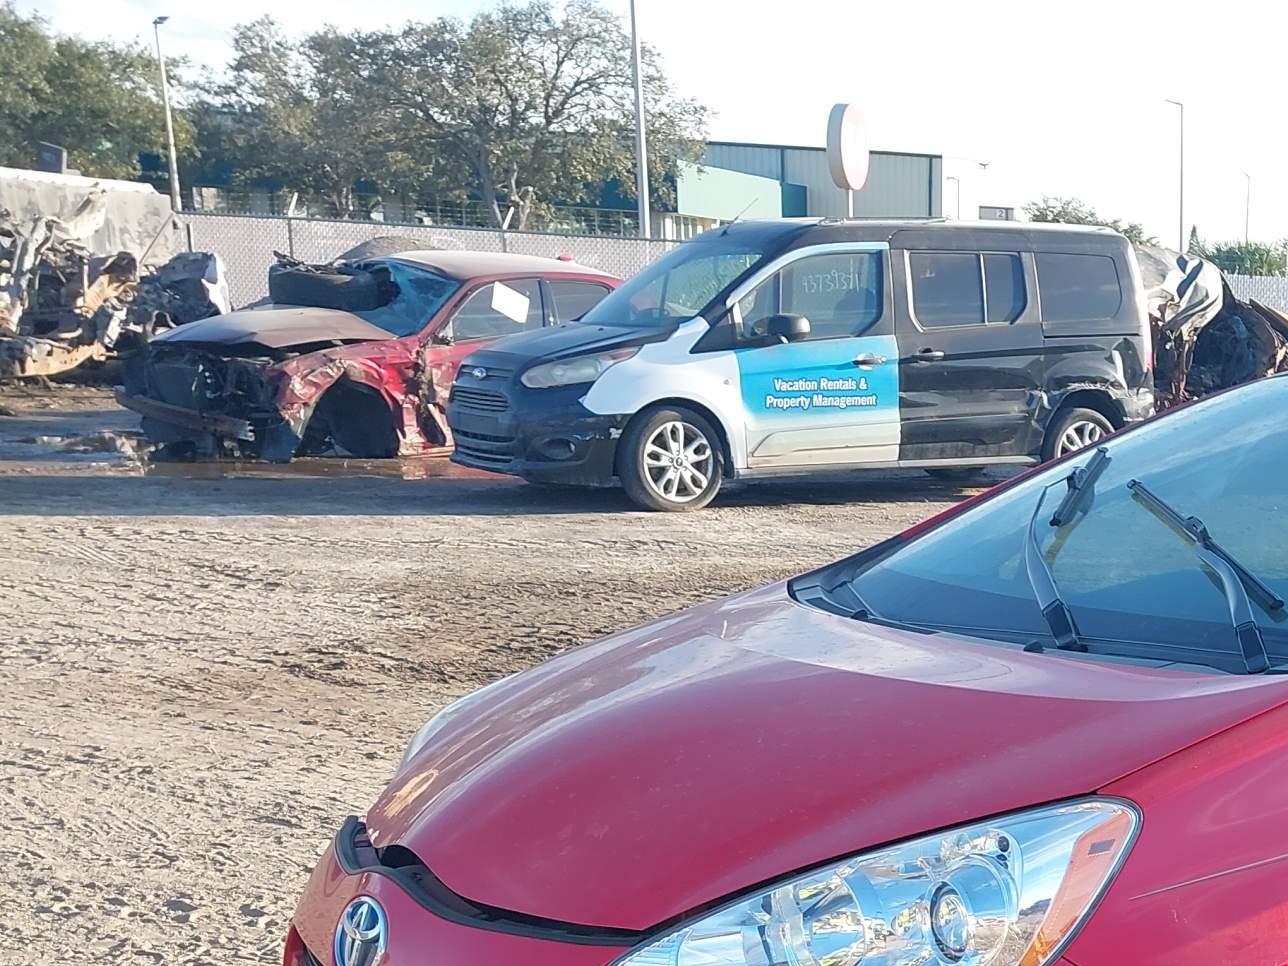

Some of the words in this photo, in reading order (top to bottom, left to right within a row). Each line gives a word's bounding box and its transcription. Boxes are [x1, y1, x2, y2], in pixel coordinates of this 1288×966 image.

[773, 377, 818, 391] Vacation
[820, 377, 857, 390] Rentals
[859, 377, 868, 390] &
[766, 394, 811, 410] Property
[812, 393, 877, 409] Management
